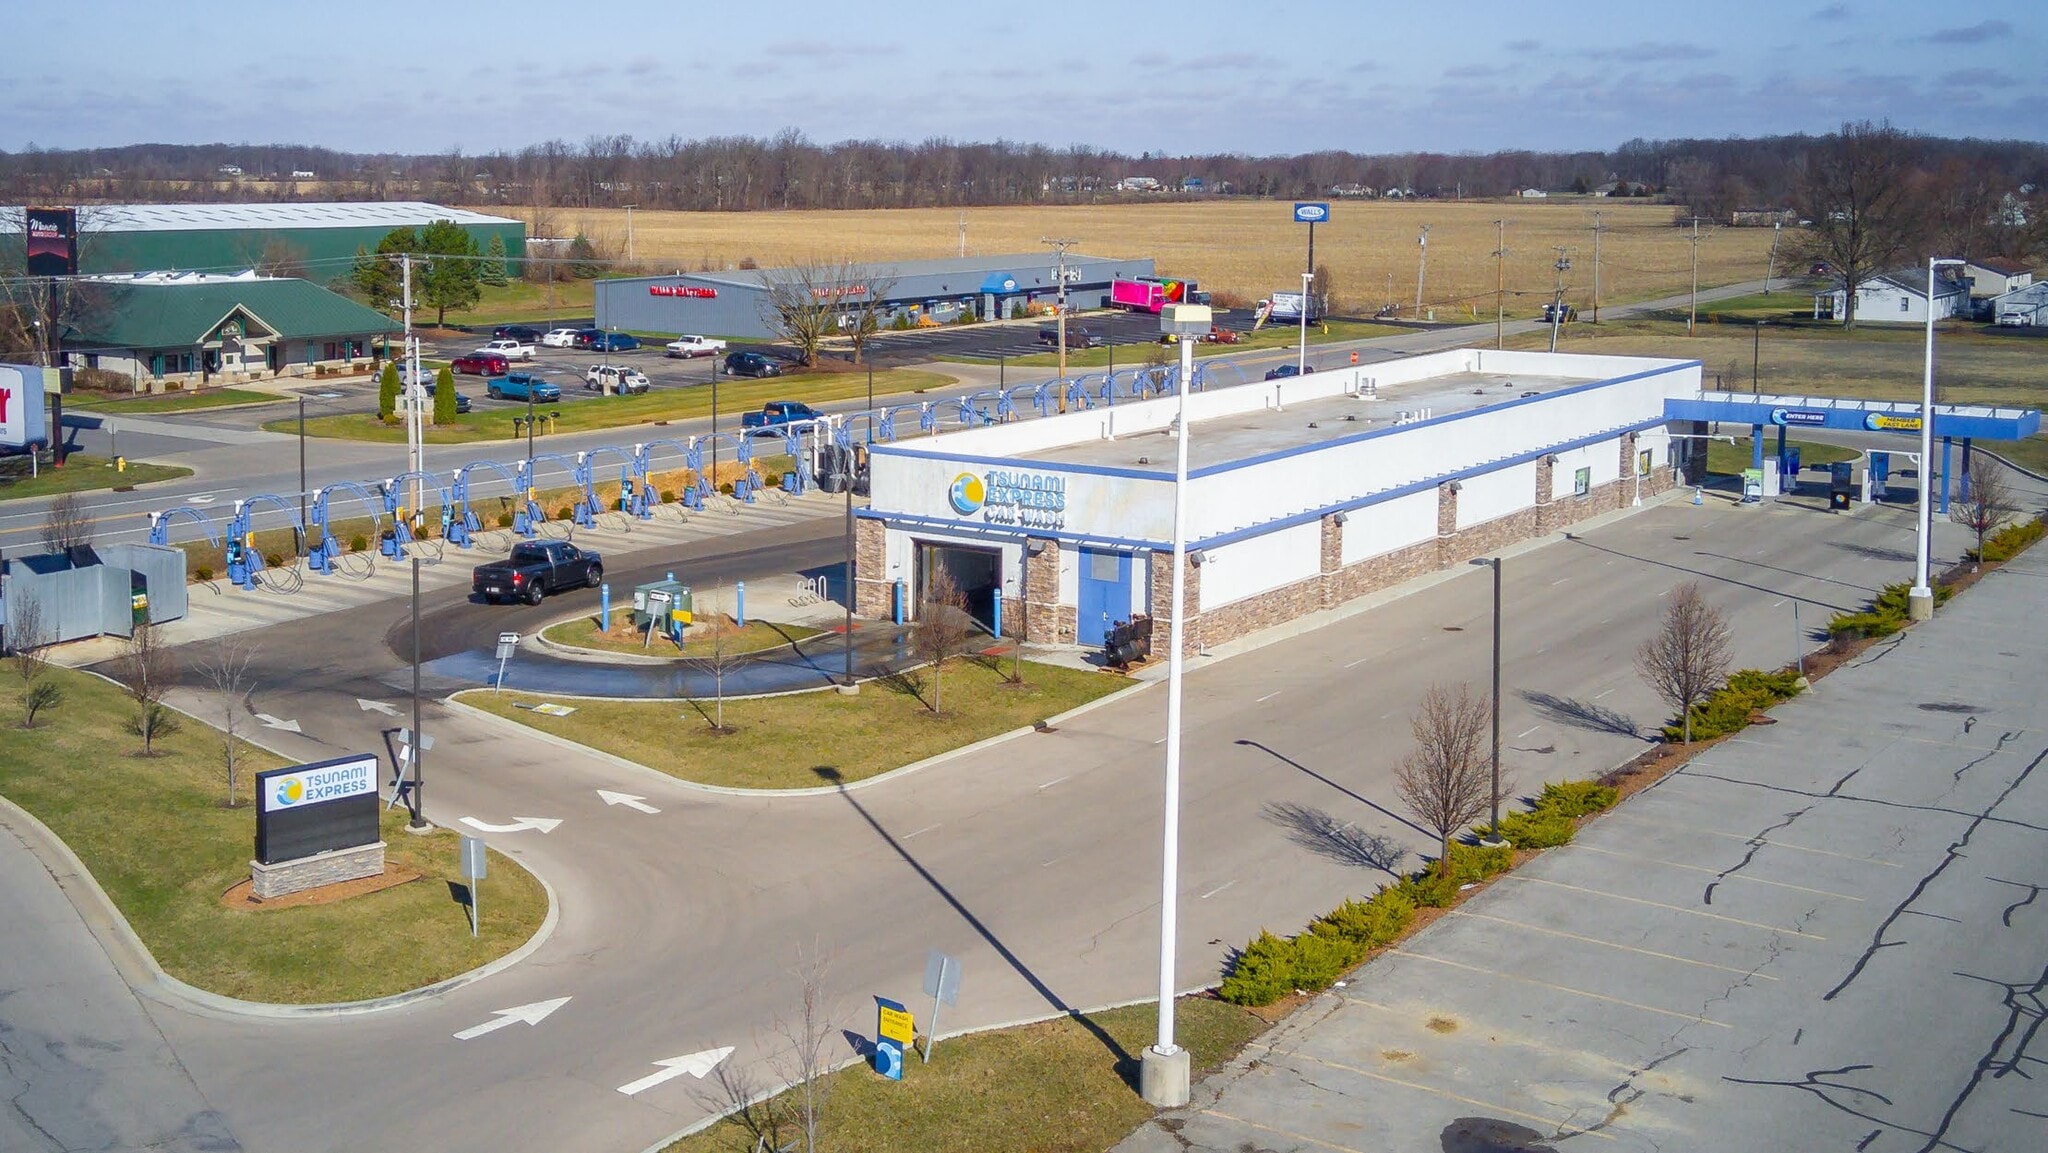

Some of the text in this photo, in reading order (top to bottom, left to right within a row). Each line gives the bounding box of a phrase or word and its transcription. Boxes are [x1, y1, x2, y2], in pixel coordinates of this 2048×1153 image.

[988, 470, 1066, 492] TSUNAMI
[986, 486, 1066, 509] EXPRESS
[306, 766, 367, 787] TSUNAMI
[305, 779, 367, 800] EXPRESS
